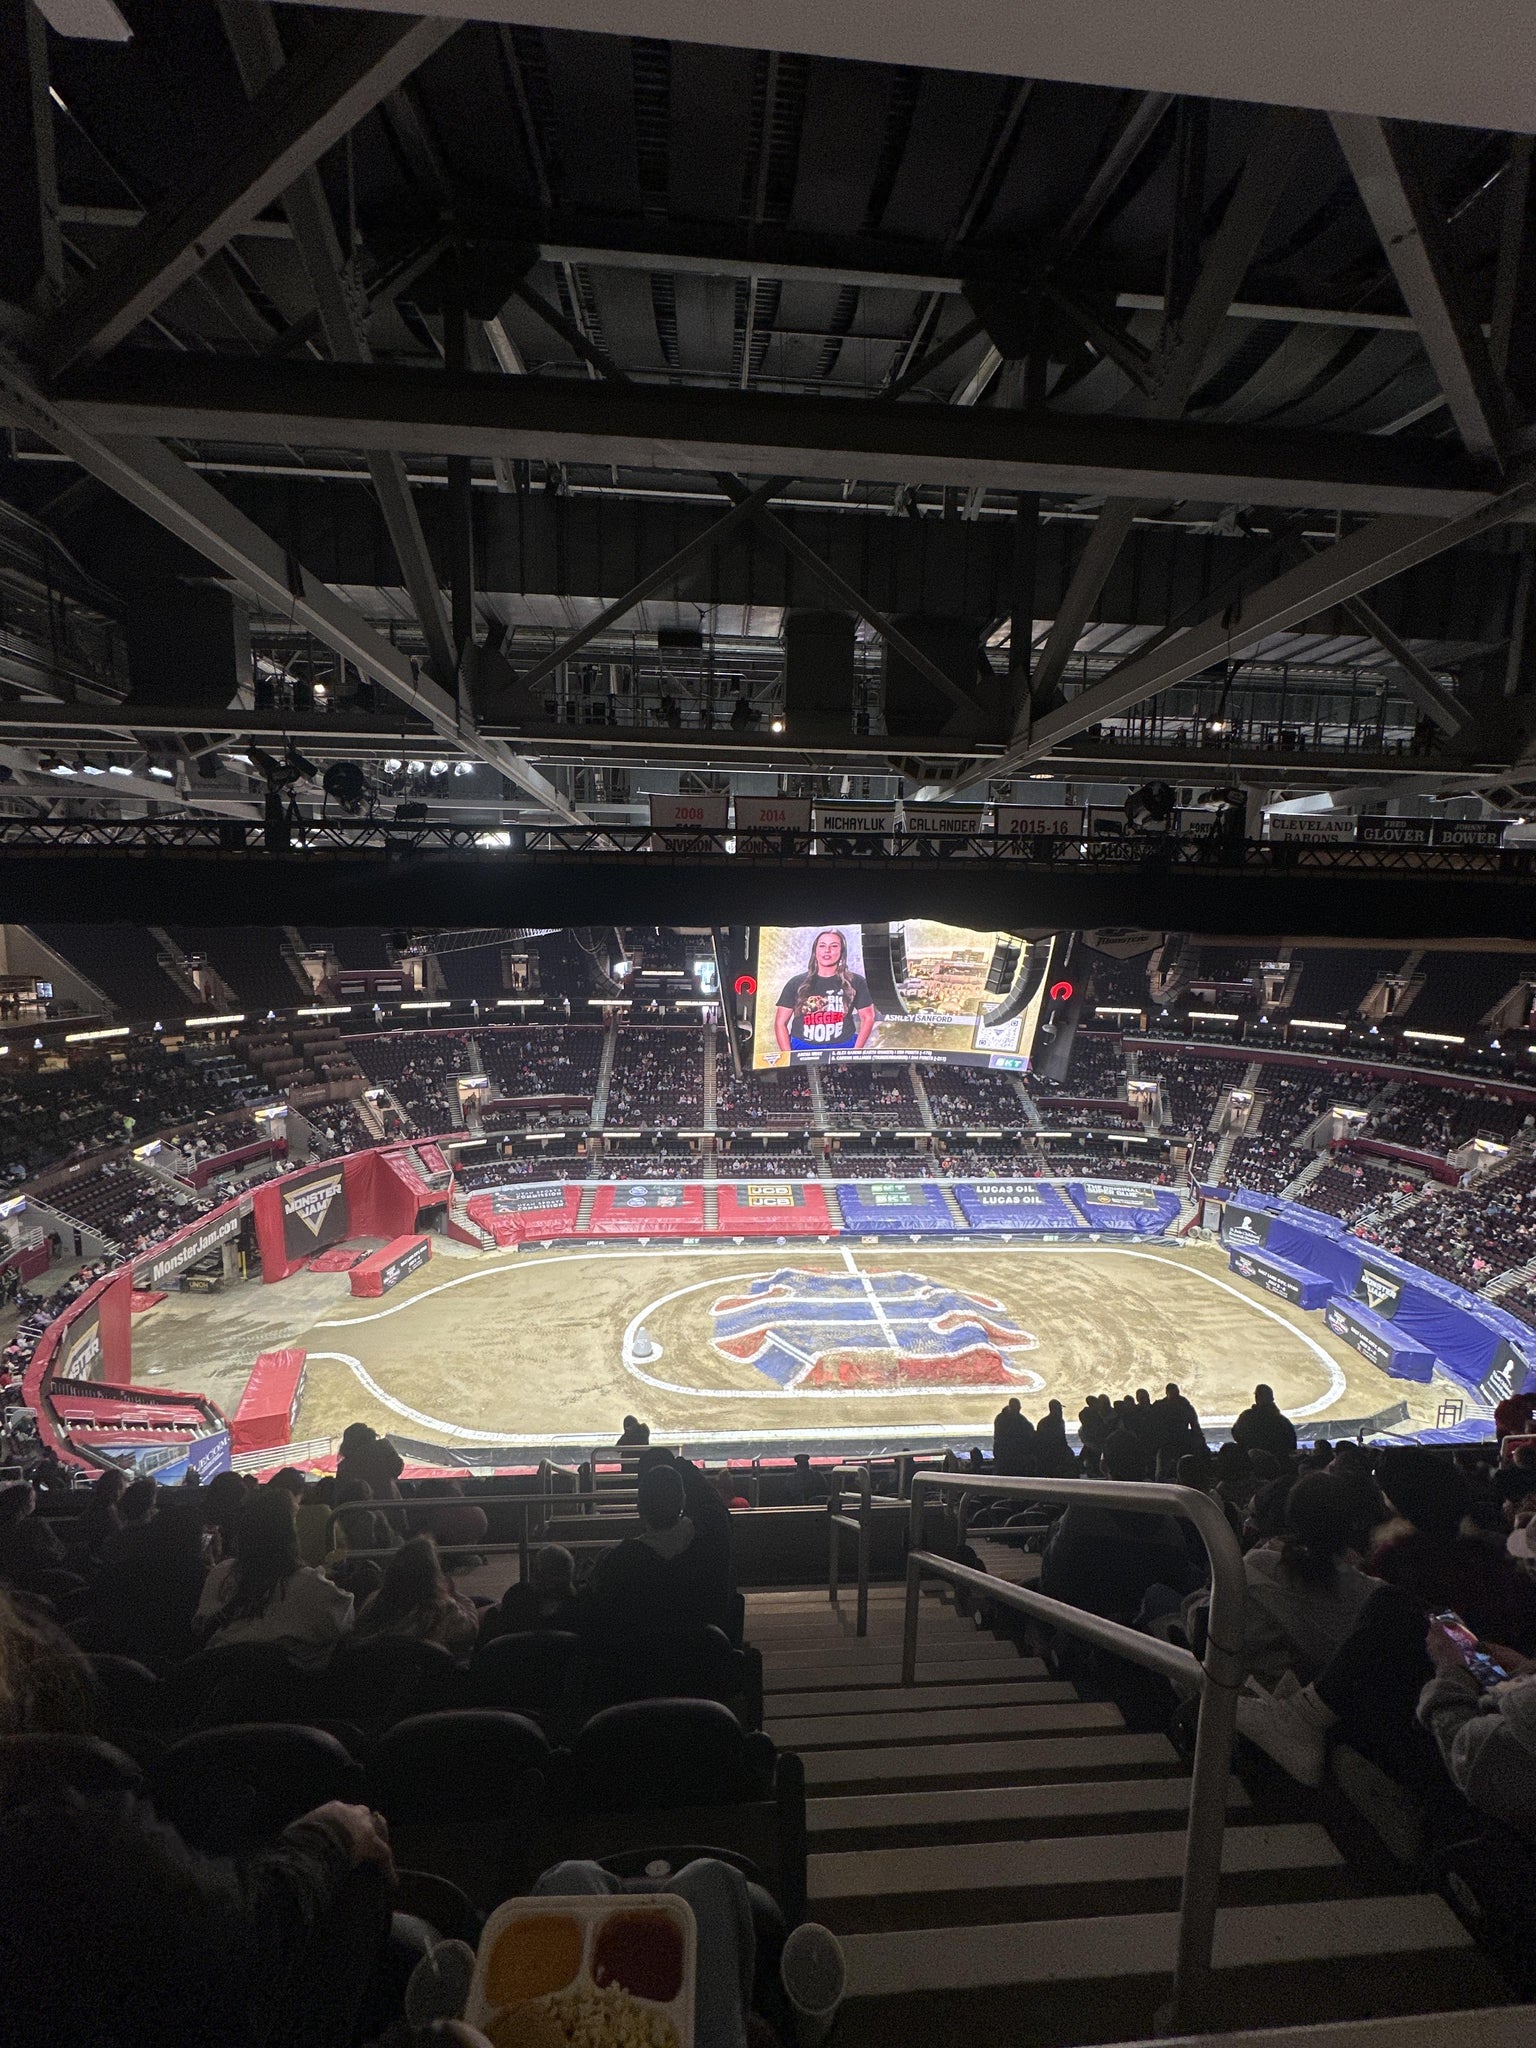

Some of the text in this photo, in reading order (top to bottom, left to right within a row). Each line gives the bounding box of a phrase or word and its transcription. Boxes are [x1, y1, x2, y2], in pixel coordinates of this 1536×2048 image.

[674, 807, 704, 820] 2008
[760, 809, 786, 822] 2014
[824, 817, 885, 831] MICHAYLUK
[909, 818, 976, 833] CALLANDER
[1011, 819, 1068, 835] 2015-16
[1272, 818, 1353, 833] CLEVELAND
[1364, 828, 1426, 843] GLOVER
[1442, 831, 1498, 845] BOWER
[884, 1014, 953, 1023] ASHLEY SANFORD
[803, 1022, 844, 1043] HOPE
[516, 1191, 562, 1199] COMMISSION
[976, 1185, 1035, 1193] LUCAS OIL
[284, 1184, 342, 1215] MONSTER
[982, 1196, 1042, 1204] LUCAS OIL
[302, 1199, 329, 1219] JAM
[517, 1203, 564, 1211] COMMISSION
[153, 1218, 238, 1282] MonsterJam.com
[1361, 1275, 1397, 1299] MONSTER
